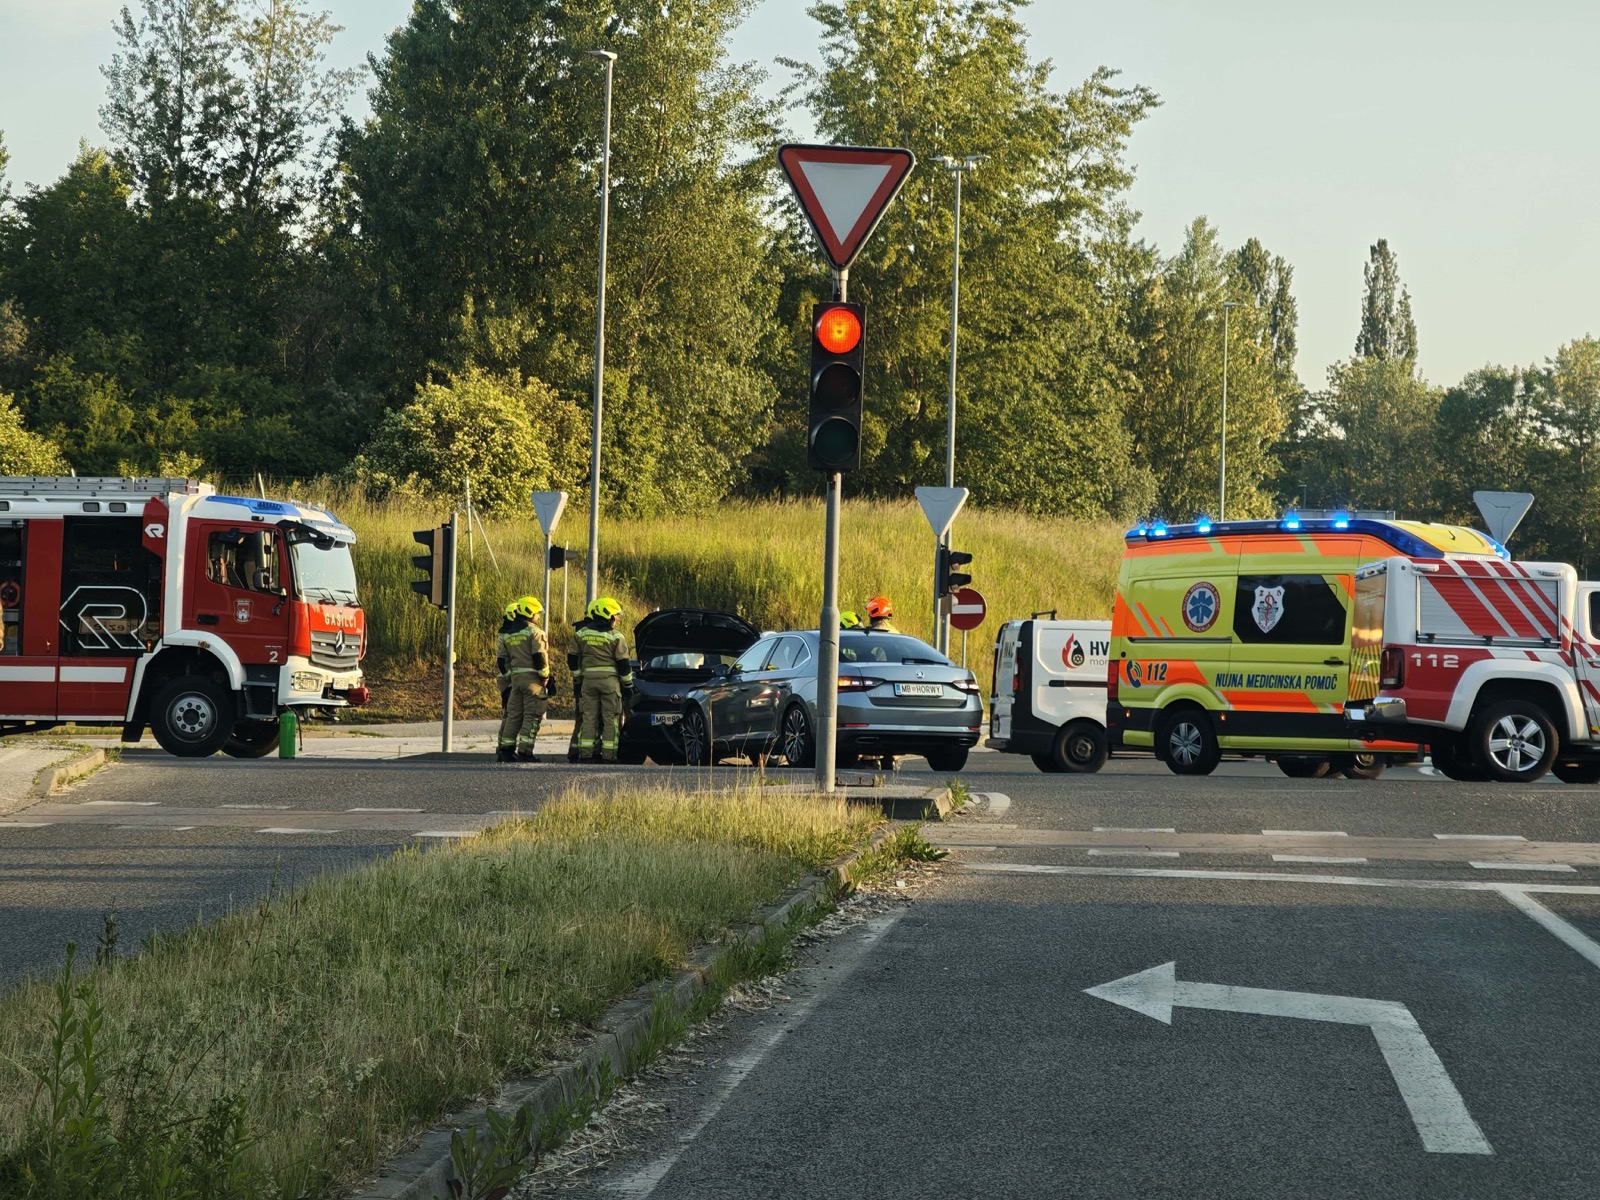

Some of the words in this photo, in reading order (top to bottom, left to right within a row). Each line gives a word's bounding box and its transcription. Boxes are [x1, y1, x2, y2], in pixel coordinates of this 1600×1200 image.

[269, 651, 279, 663] 2
[1411, 653, 1459, 669] 112
[1147, 662, 1168, 681] 112
[901, 685, 911, 693] MB
[916, 685, 941, 694] HORWY
[1215, 673, 1243, 688] NUJNA
[1246, 674, 1302, 690] MEDICINSKA
[1304, 674, 1338, 691] POMOČ
